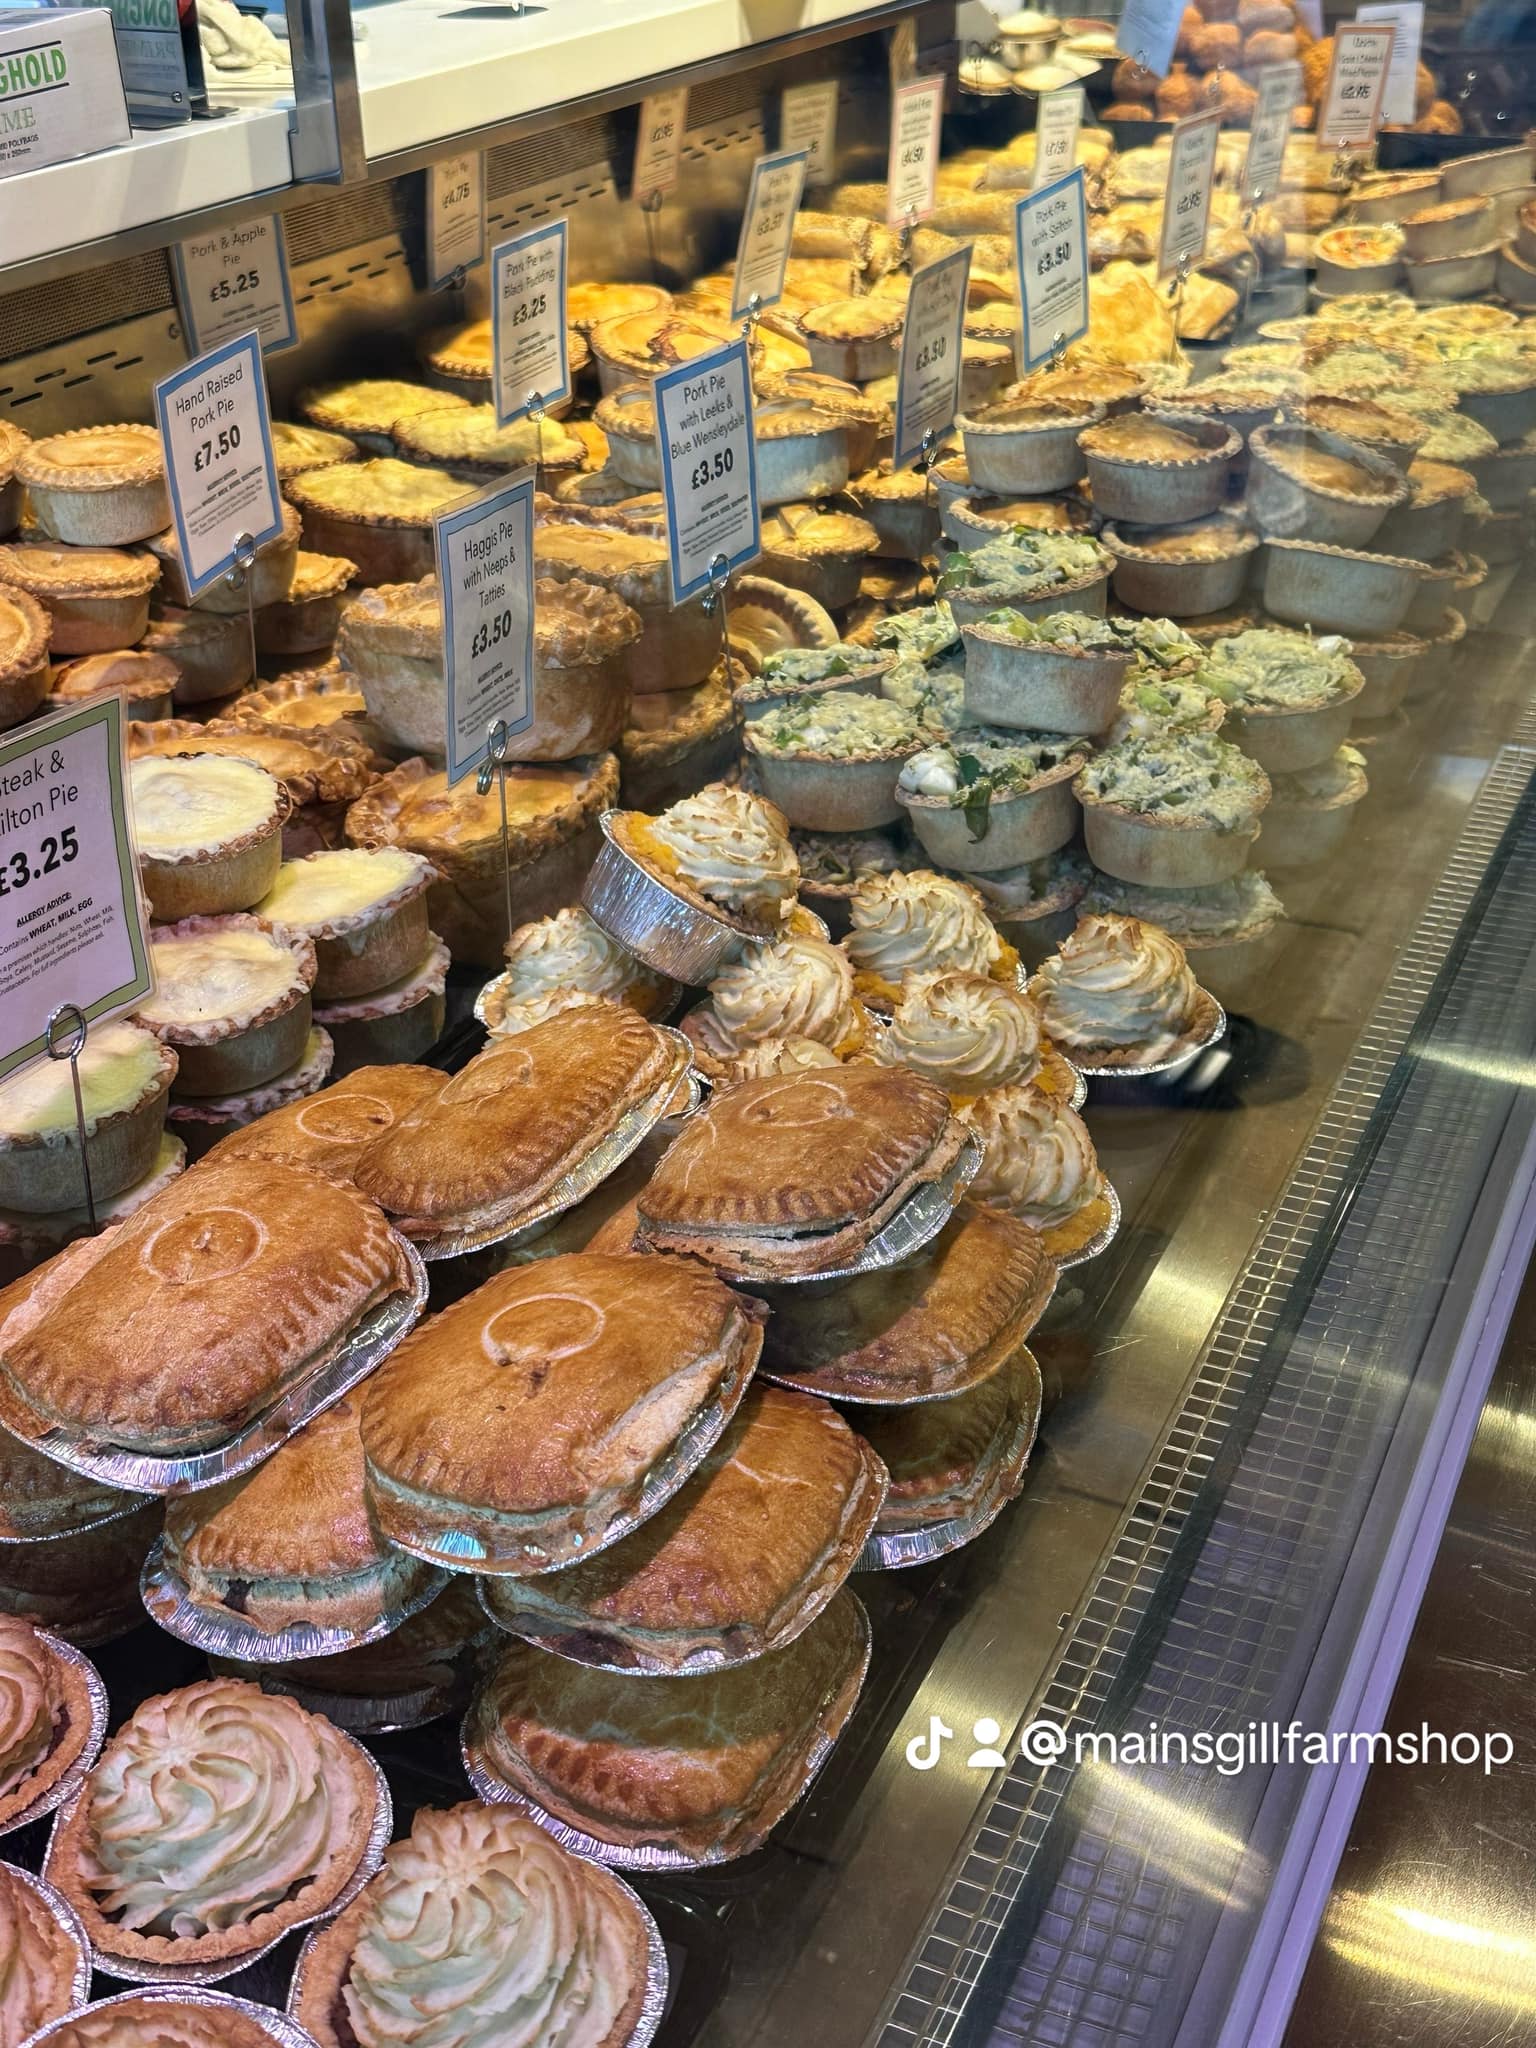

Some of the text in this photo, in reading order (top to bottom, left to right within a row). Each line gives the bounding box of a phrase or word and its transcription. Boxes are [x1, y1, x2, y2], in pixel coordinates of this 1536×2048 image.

[0, 106, 36, 134] ME
[192, 226, 266, 257] Pork & Apple
[223, 254, 241, 268] Pie
[1037, 241, 1072, 276] £3.50
[209, 270, 260, 303] £5.25
[512, 293, 547, 327] £3.25
[176, 363, 243, 417] Hand Raised
[684, 375, 726, 404] Pork Pie
[191, 398, 235, 433] Pork Pie
[680, 393, 733, 431] with Leeks &
[194, 424, 241, 473] £7.50
[671, 412, 745, 460] Blue Wensleydale
[692, 447, 734, 490] £3.50
[464, 521, 513, 562] Haggis Pie
[463, 546, 516, 590] with Neeps &
[479, 583, 505, 608] Tatties
[472, 609, 512, 659] £3.50
[0, 750, 65, 798] teak &
[0, 784, 79, 837] ilton Pie
[0, 825, 79, 898] £3.25
[17, 904, 46, 928] ALLERGY
[29, 918, 58, 939] WHEAT,
[78, 897, 93, 911] EGG
